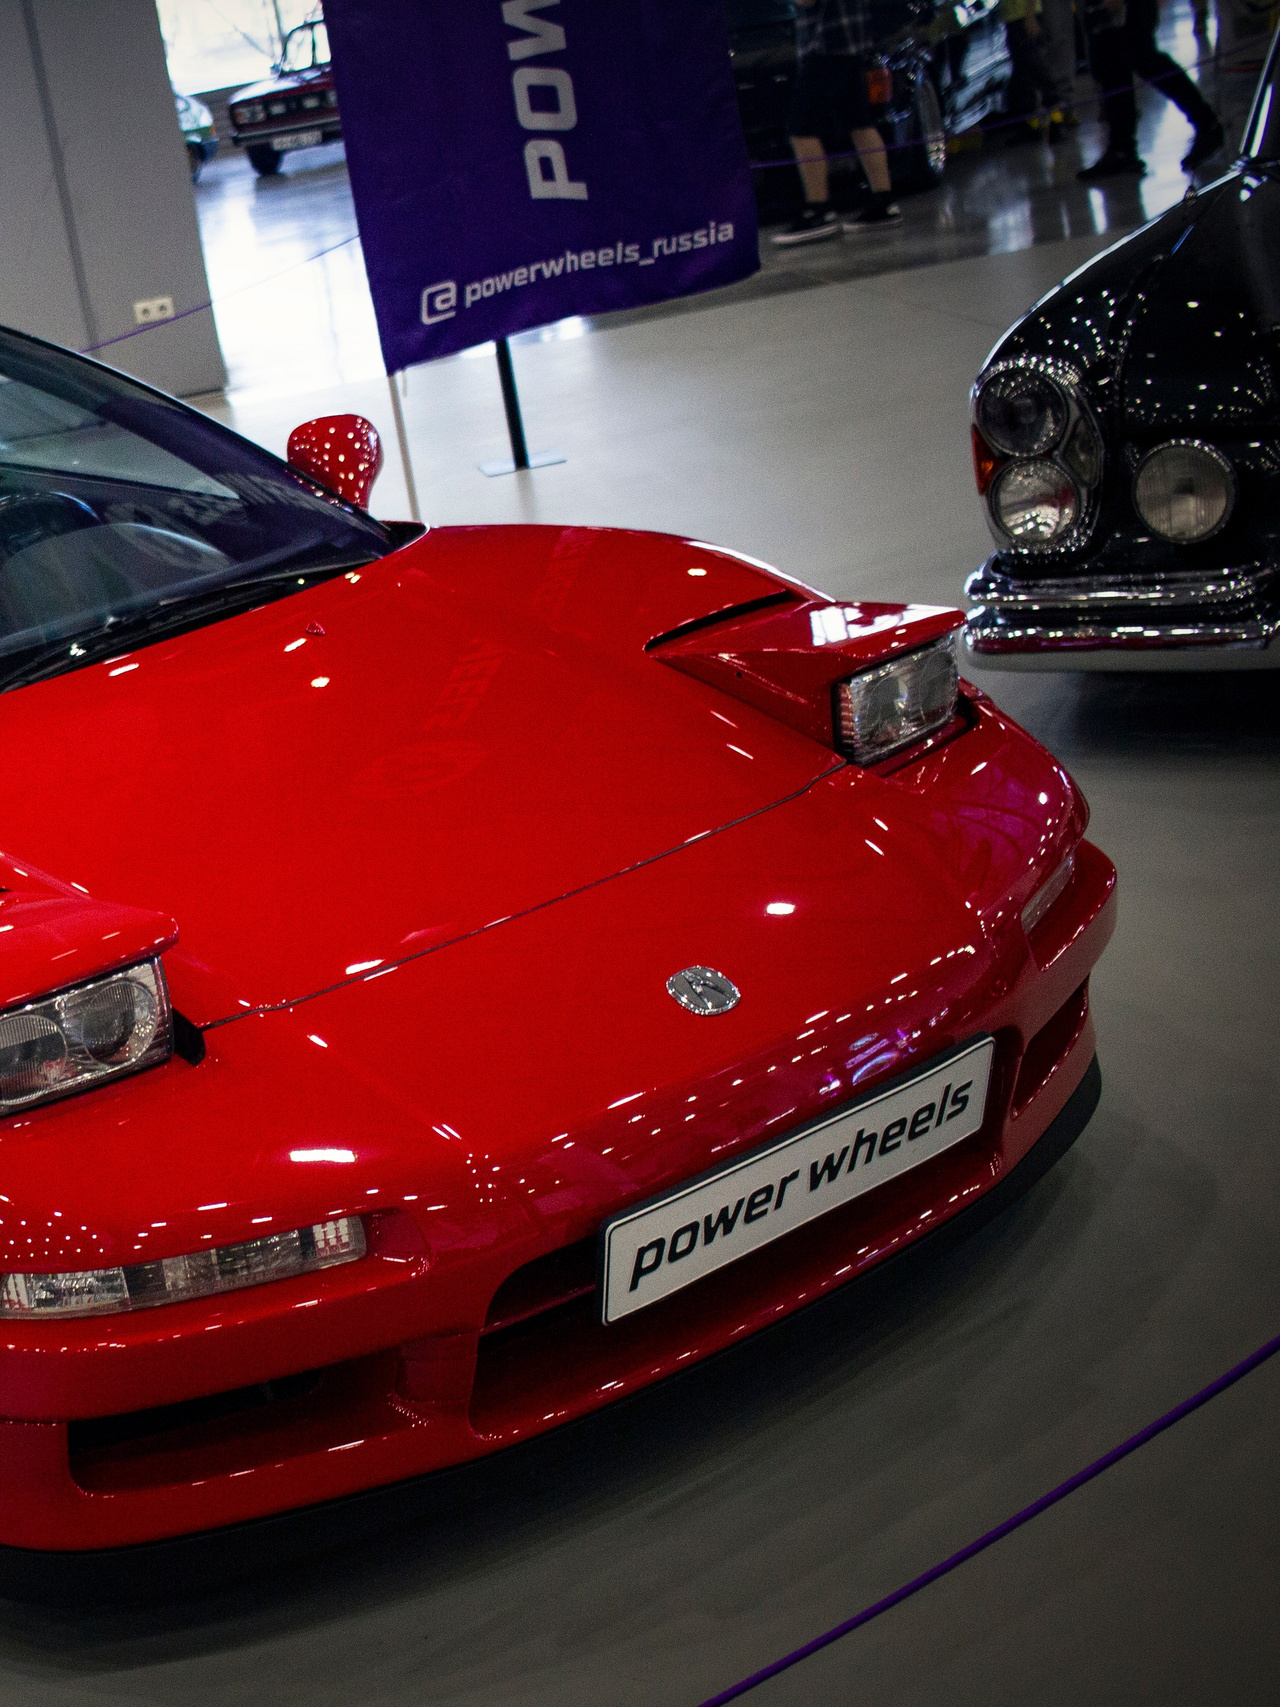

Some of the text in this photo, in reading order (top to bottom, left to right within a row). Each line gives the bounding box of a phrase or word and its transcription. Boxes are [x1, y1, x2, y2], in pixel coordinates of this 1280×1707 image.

[501, 0, 588, 200] POW
[464, 220, 735, 308] powerwheels_russia
[628, 1080, 974, 1292] power wheels
